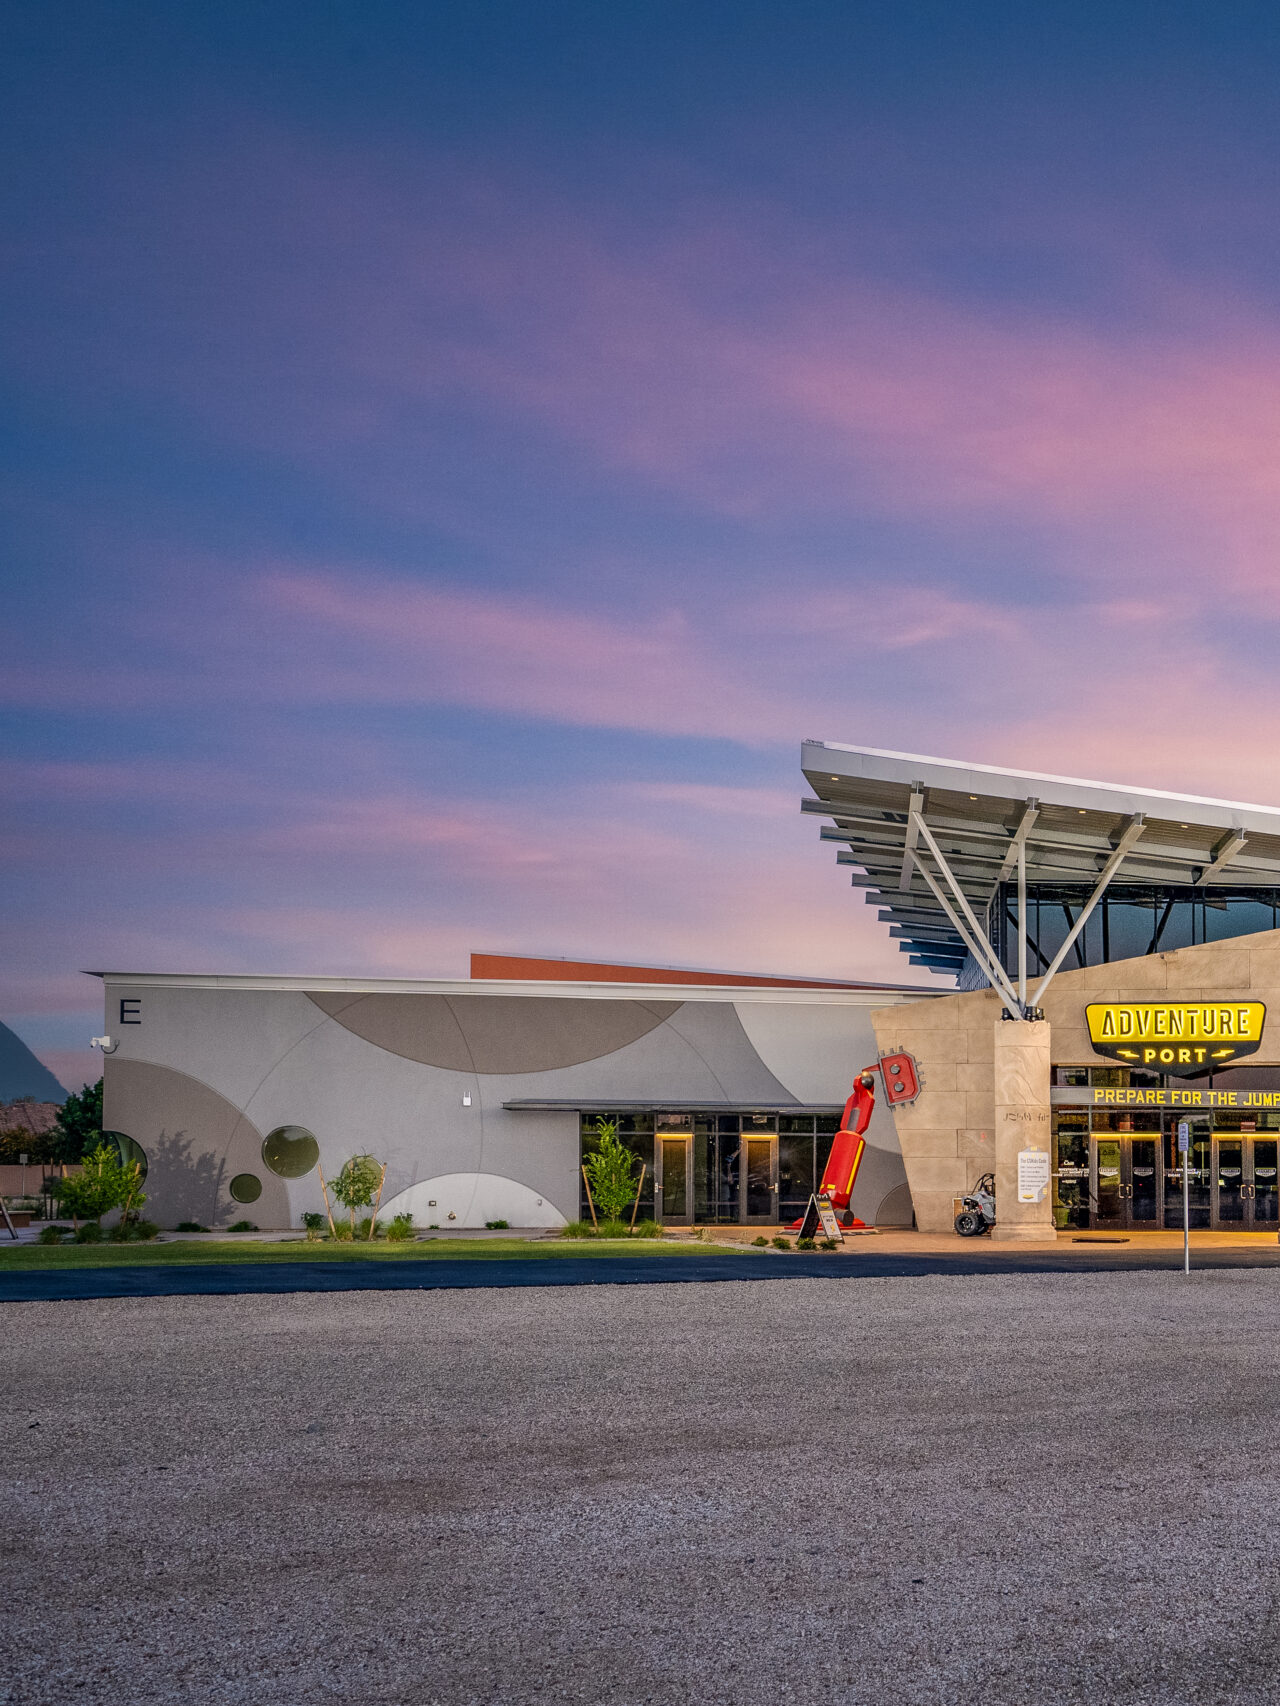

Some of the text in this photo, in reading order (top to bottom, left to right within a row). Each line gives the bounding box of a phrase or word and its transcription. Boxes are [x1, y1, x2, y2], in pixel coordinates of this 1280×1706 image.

[120, 999, 142, 1024] E
[1102, 1009, 1249, 1036] ADVENTURE
[1144, 1048, 1207, 1063] PORT
[1094, 1089, 1166, 1105] PREPARE
[1171, 1090, 1202, 1105] FOR
[1207, 1091, 1238, 1106] THE
